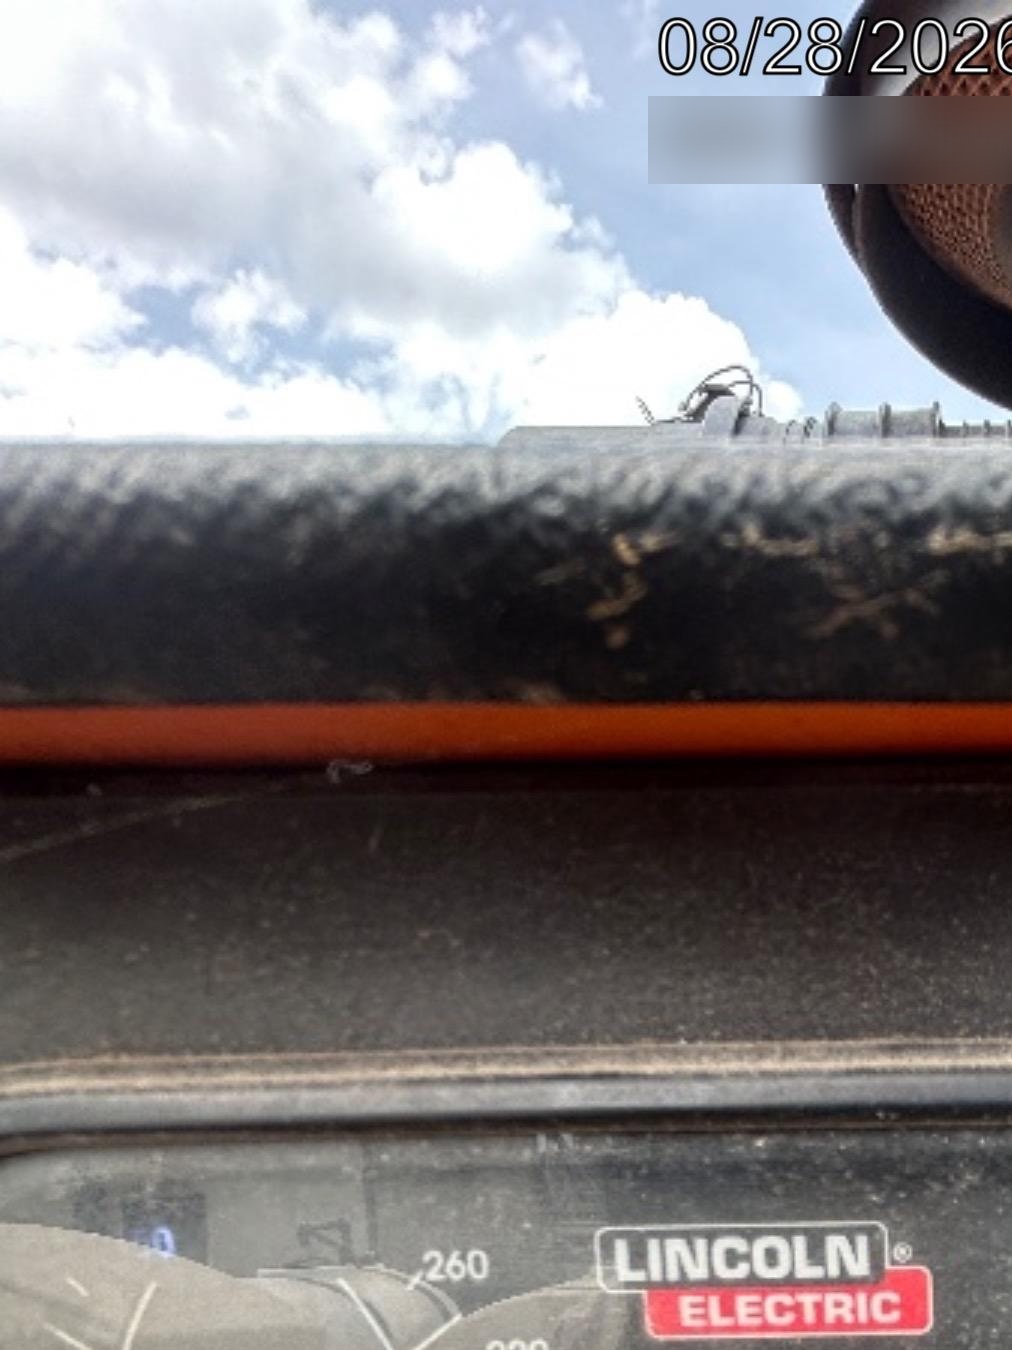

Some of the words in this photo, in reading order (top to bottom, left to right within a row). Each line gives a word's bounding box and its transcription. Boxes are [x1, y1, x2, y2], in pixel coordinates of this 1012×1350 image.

[423, 1250, 489, 1280] 260
[612, 1234, 872, 1283] LINCOLN
[678, 1291, 902, 1328] ELECTRIC
